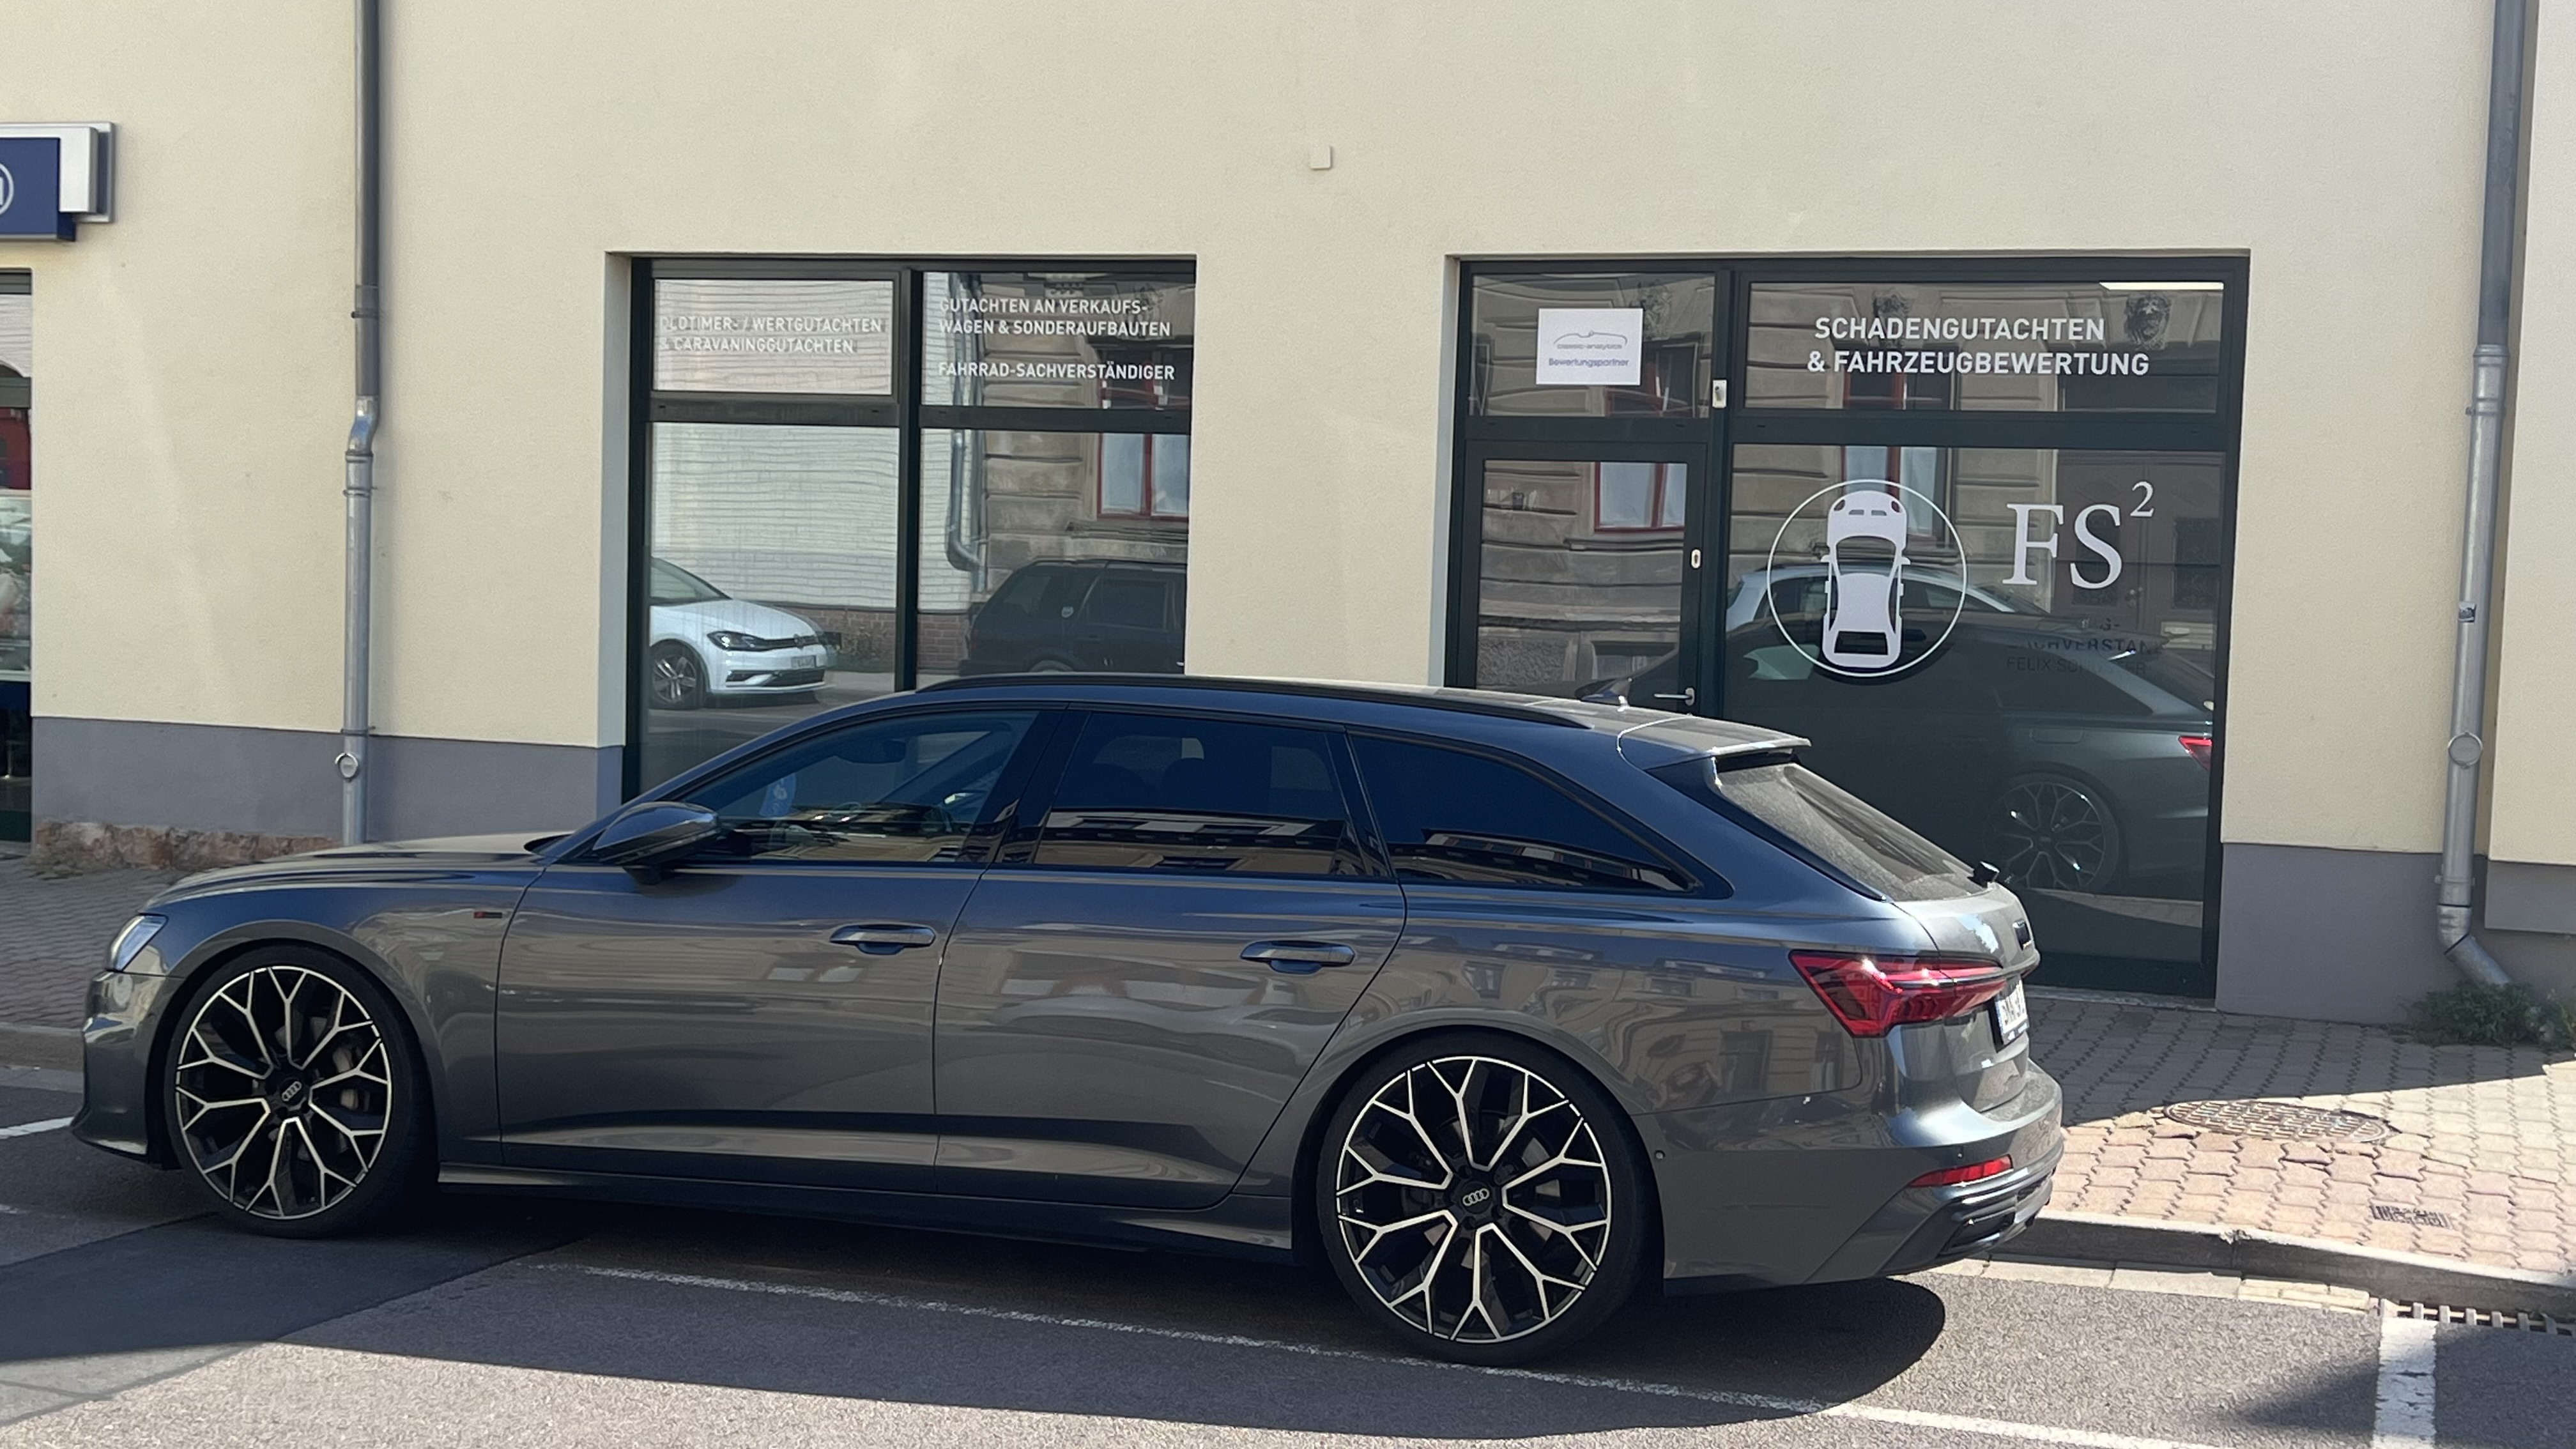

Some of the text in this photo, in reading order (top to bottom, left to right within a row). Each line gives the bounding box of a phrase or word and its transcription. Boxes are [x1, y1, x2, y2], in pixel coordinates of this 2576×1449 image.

[939, 298, 1148, 315] GUTACHTEN AN VERKAUFS-
[753, 318, 882, 333] WERTGUTACHTEN
[939, 320, 1170, 337] WAGEN & SONDERAUFBAUTEN
[1814, 317, 2104, 341] SCHADENGUTACHTEN
[674, 337, 854, 353] CARAVANINGGUTACHTEN
[939, 361, 1176, 381] FAHRRAD-SACHVERSTÄNDIGER
[1548, 357, 1630, 368] Bewertungspartner
[1807, 351, 2150, 376] & FAHRZEUGBEWERTUNG
[2007, 656, 2051, 671] FELIX
